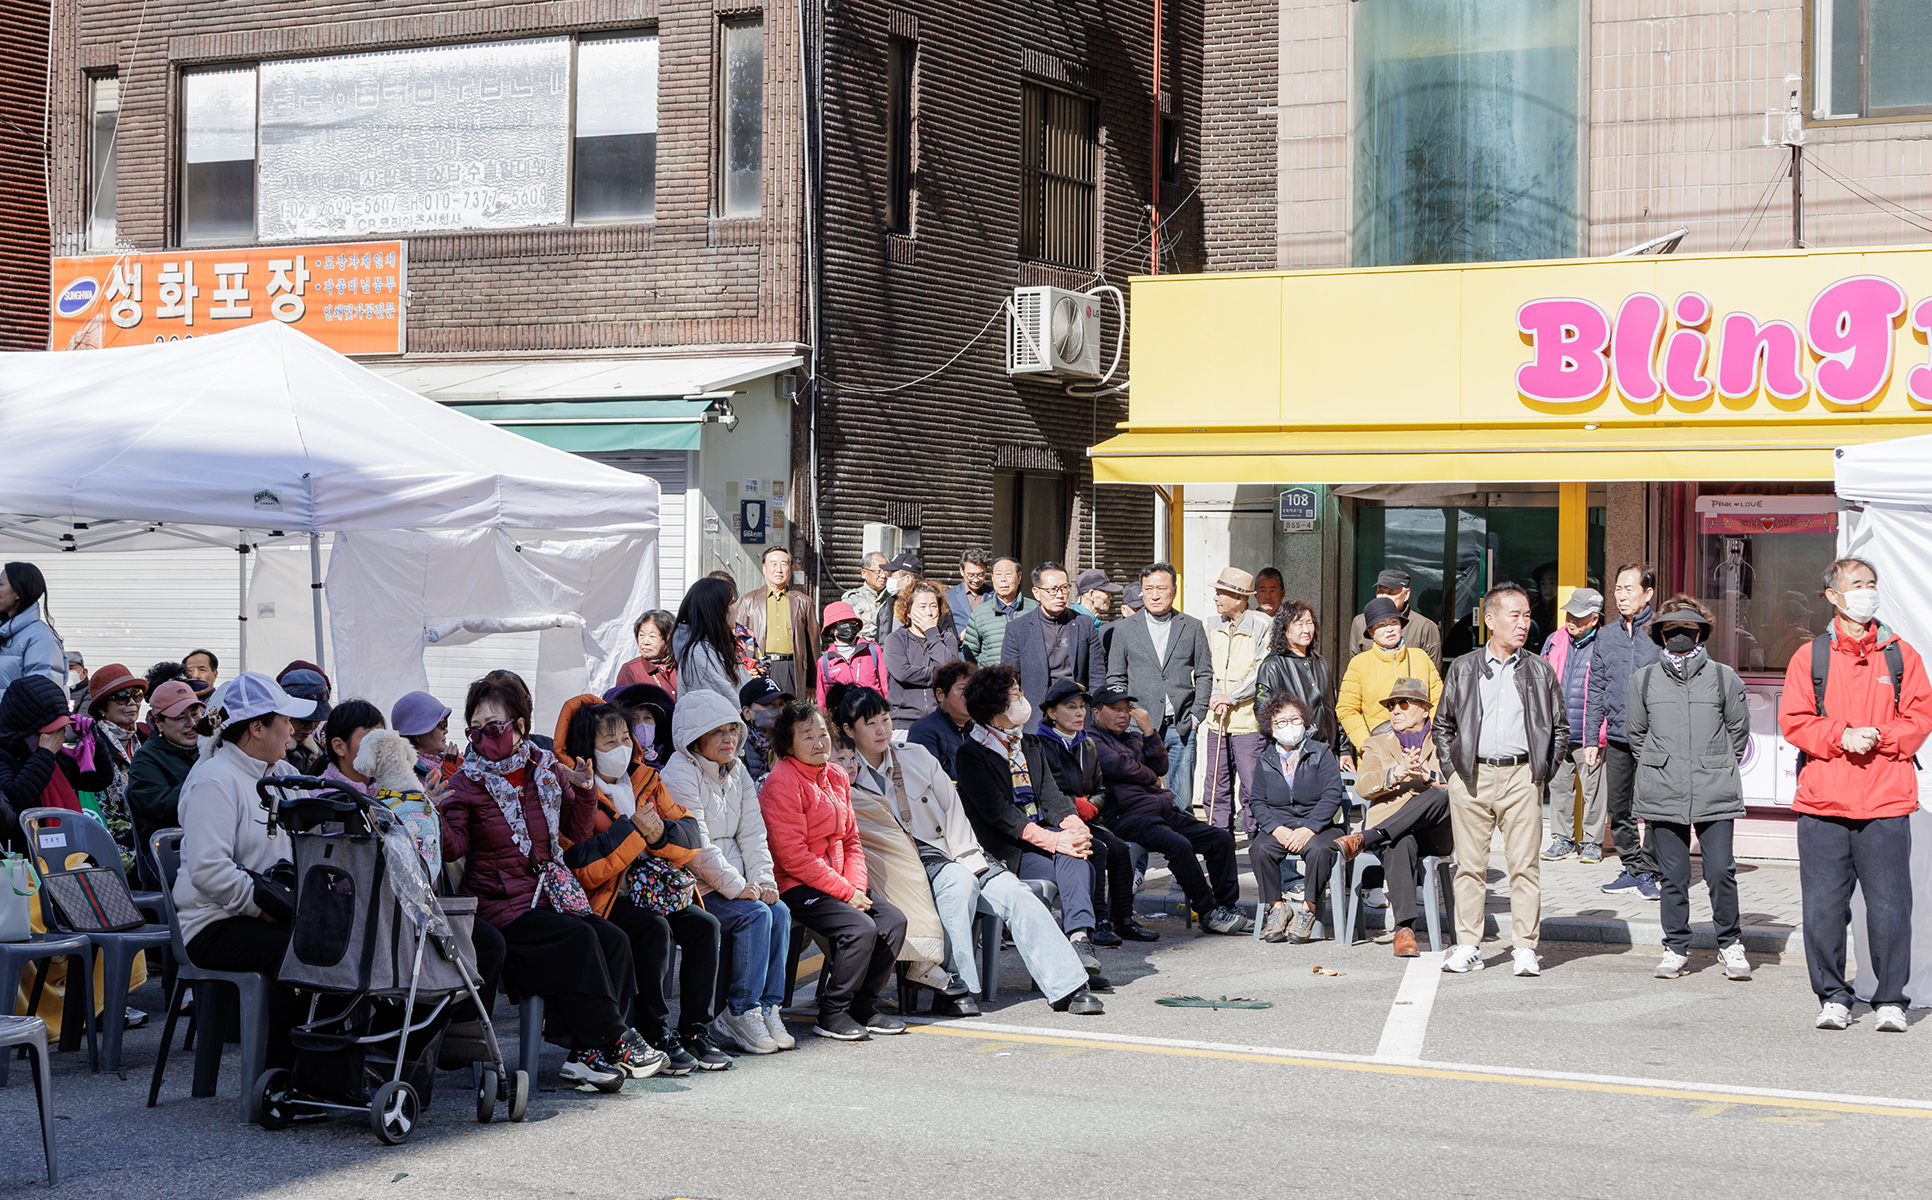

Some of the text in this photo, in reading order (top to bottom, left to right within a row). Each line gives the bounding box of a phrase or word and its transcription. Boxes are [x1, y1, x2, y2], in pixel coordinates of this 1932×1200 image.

[323, 250, 396, 271] 포장자재일체
[63, 289, 94, 302] SUNGHWA
[104, 254, 312, 329] 성화포장
[322, 275, 397, 296] 각종비닐봉투
[323, 301, 396, 321] 인쇄및가공전문
[1514, 273, 1909, 411] Bling
[1287, 493, 1309, 506] 108
[1711, 500, 1732, 508] PINK
[1285, 521, 1311, 529] 855-4
